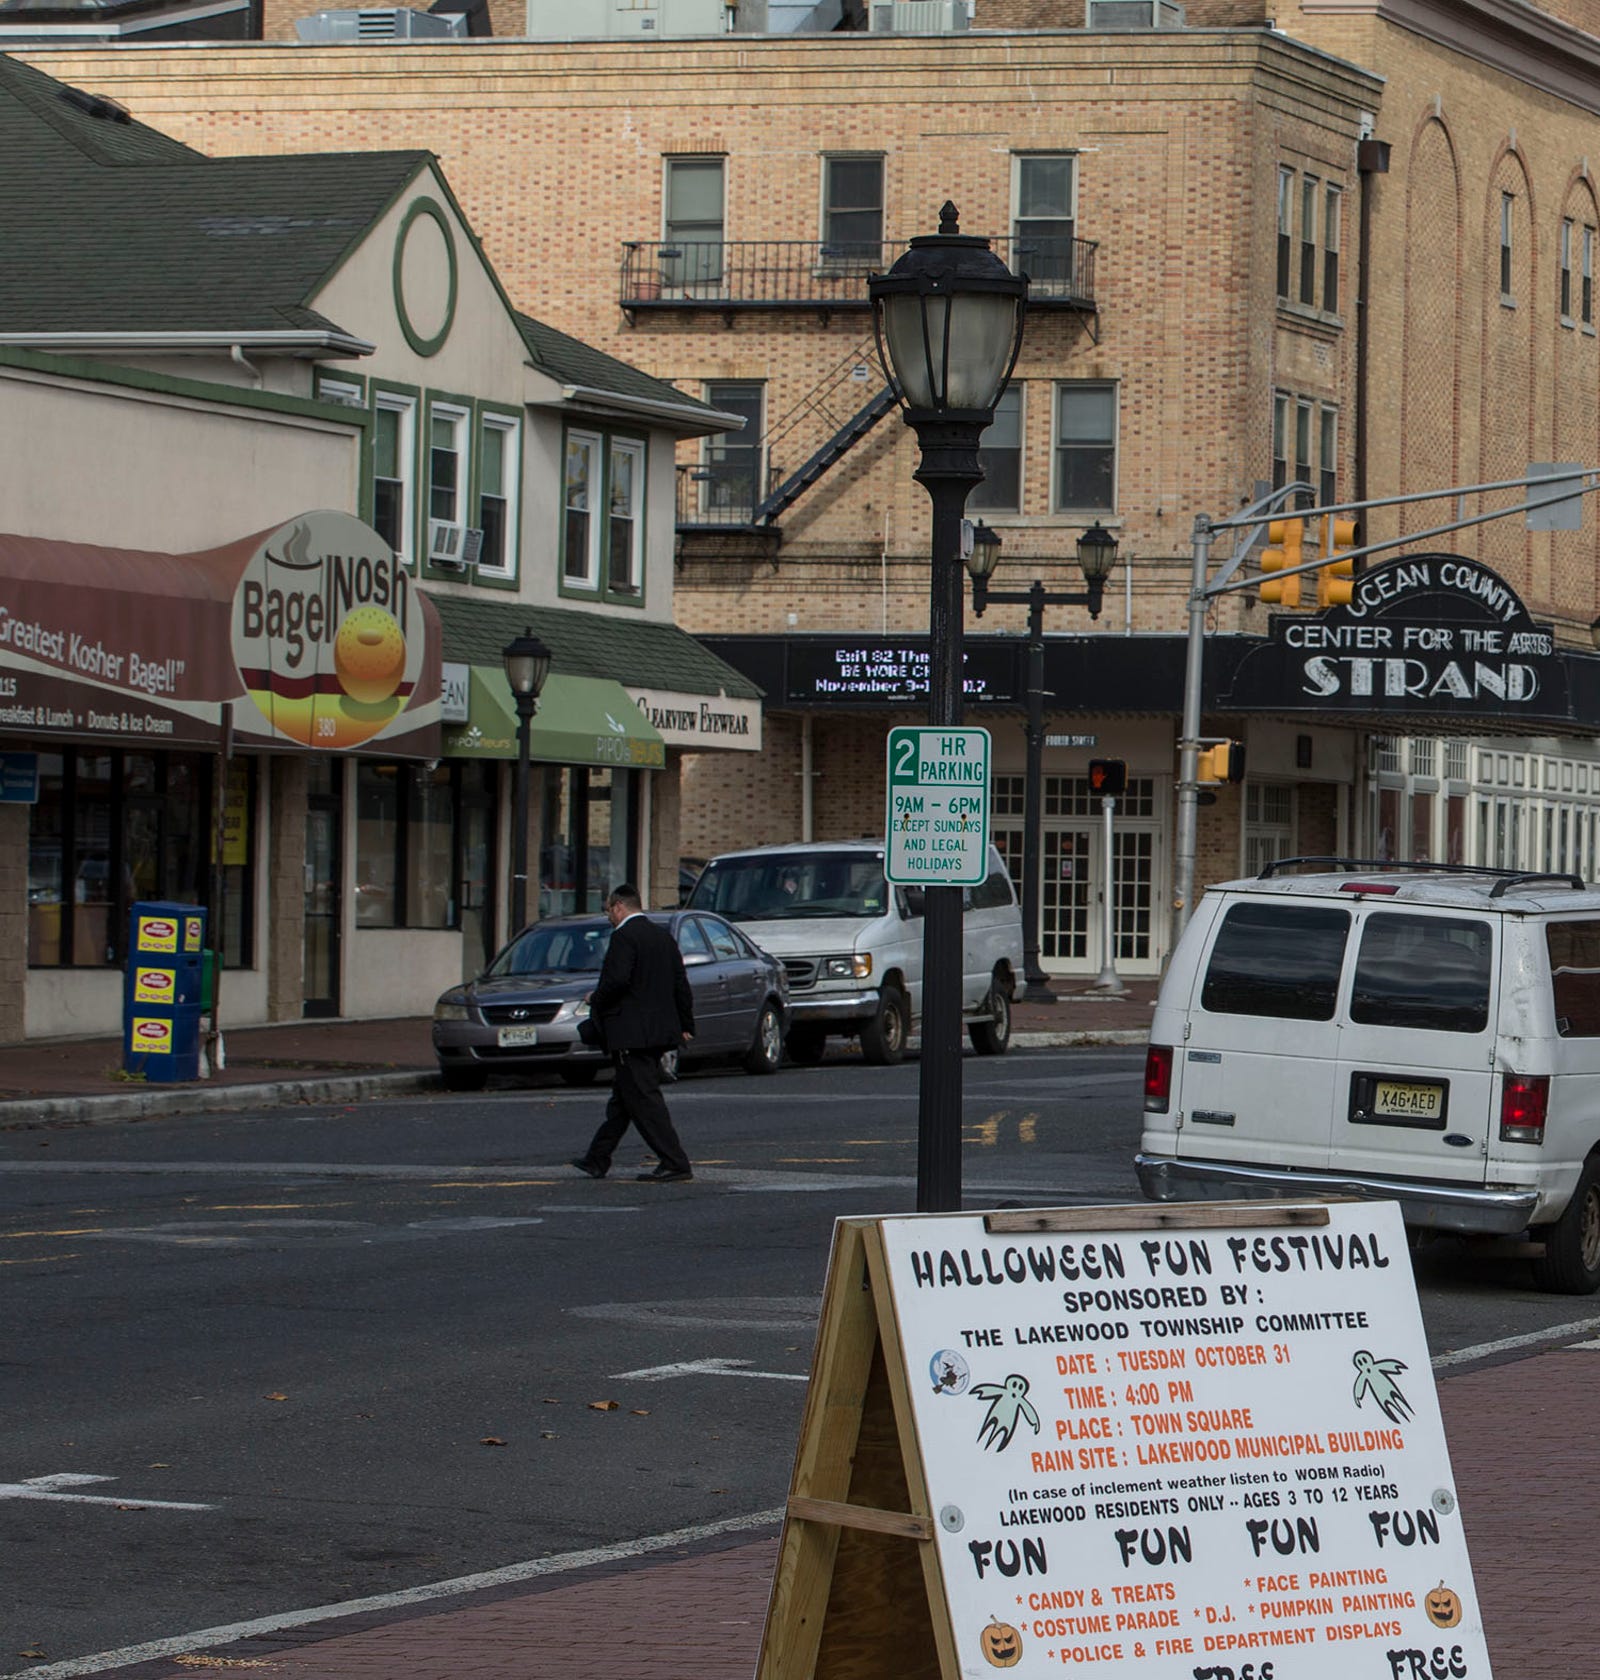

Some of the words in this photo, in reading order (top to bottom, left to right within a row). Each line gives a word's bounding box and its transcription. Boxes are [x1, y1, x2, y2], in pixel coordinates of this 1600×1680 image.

[1440, 563, 1520, 622] COUNTY
[1285, 625, 1392, 649] CENTER
[1403, 627, 1454, 651] FOR
[1459, 629, 1504, 654] THE
[1507, 632, 1553, 657] ARTS
[69, 633, 124, 680] Kosher
[816, 679, 900, 692] November
[1302, 656, 1540, 700] STRAND
[46, 707, 74, 729] Lunch
[88, 709, 119, 730] Donuts
[145, 714, 173, 734] Cream
[317, 717, 336, 737] 380
[895, 738, 915, 776] 2
[941, 737, 966, 755] HR
[920, 761, 982, 781] PARKING
[895, 796, 924, 813] 9AM
[948, 797, 980, 814] 6PM
[893, 820, 930, 832] EXCEPT
[934, 820, 981, 833] SUNDAYS
[904, 839, 926, 851] AND
[932, 839, 968, 851] LEGAL
[908, 857, 962, 870] HOLIDAYS
[911, 1243, 1125, 1288] HALLOWEEN
[1140, 1240, 1212, 1277] FUN
[1227, 1233, 1390, 1274] FESTIVAL
[1063, 1286, 1208, 1313] SPONSORED
[961, 1329, 1003, 1348] THE
[1015, 1321, 1129, 1345] LAKEWOOD
[1140, 1316, 1244, 1338] TOWNSHIP
[1256, 1312, 1369, 1333] COMMITTEE
[1117, 1348, 1186, 1372] TUESDAY
[1195, 1344, 1267, 1368] OCTOBER
[1273, 1343, 1291, 1364] 31
[1125, 1382, 1160, 1405] 4:00
[1167, 1380, 1194, 1404] PM
[1131, 1411, 1182, 1436] TOWN
[1187, 1408, 1254, 1432] SQUARE
[1031, 1449, 1075, 1473] RAIN
[1137, 1438, 1231, 1466] LAKEWOOD
[1235, 1434, 1324, 1459] MUNICIPAL
[1328, 1429, 1404, 1454] BUILDING
[1008, 1488, 1029, 1504] (In
[1033, 1487, 1067, 1500] case
[1071, 1483, 1085, 1498] of
[1089, 1478, 1162, 1496] inclement
[1167, 1475, 1226, 1491] weather
[1230, 1472, 1269, 1486] listen
[1272, 1470, 1288, 1483] to
[1295, 1466, 1339, 1481] WOBM
[1342, 1464, 1385, 1479] Radio)
[1000, 1505, 1086, 1527] LAKEWOOD
[1095, 1498, 1180, 1520] RESIDENTS
[1188, 1495, 1224, 1513] ONLY
[1243, 1491, 1280, 1510] AGES
[1288, 1490, 1297, 1505] 3
[1304, 1488, 1324, 1504] TO
[1332, 1487, 1348, 1502] 12
[1355, 1483, 1399, 1500] YEARS
[968, 1537, 1047, 1579] FUN
[1115, 1525, 1192, 1568] FUN
[1246, 1516, 1320, 1557] FUN
[1369, 1509, 1440, 1548] FUN
[1257, 1574, 1300, 1592] FACE
[1309, 1567, 1388, 1589] PAINTING
[1028, 1589, 1084, 1611] CANDY
[1091, 1588, 1103, 1606] &
[1111, 1582, 1176, 1604] TREATS
[1033, 1614, 1112, 1638] COSTUME
[1116, 1609, 1181, 1631] PARADE
[1205, 1605, 1236, 1624] D.J.
[1260, 1596, 1334, 1619] PUMPKIN
[1342, 1591, 1416, 1613] PAINTING
[1060, 1643, 1124, 1664] POLICE
[1134, 1641, 1146, 1659] &
[1155, 1638, 1194, 1656] FIRE
[1204, 1627, 1316, 1651] DEPARTMENT
[1326, 1620, 1402, 1642] DISPLAYS
[1387, 1645, 1467, 1680] FREE
